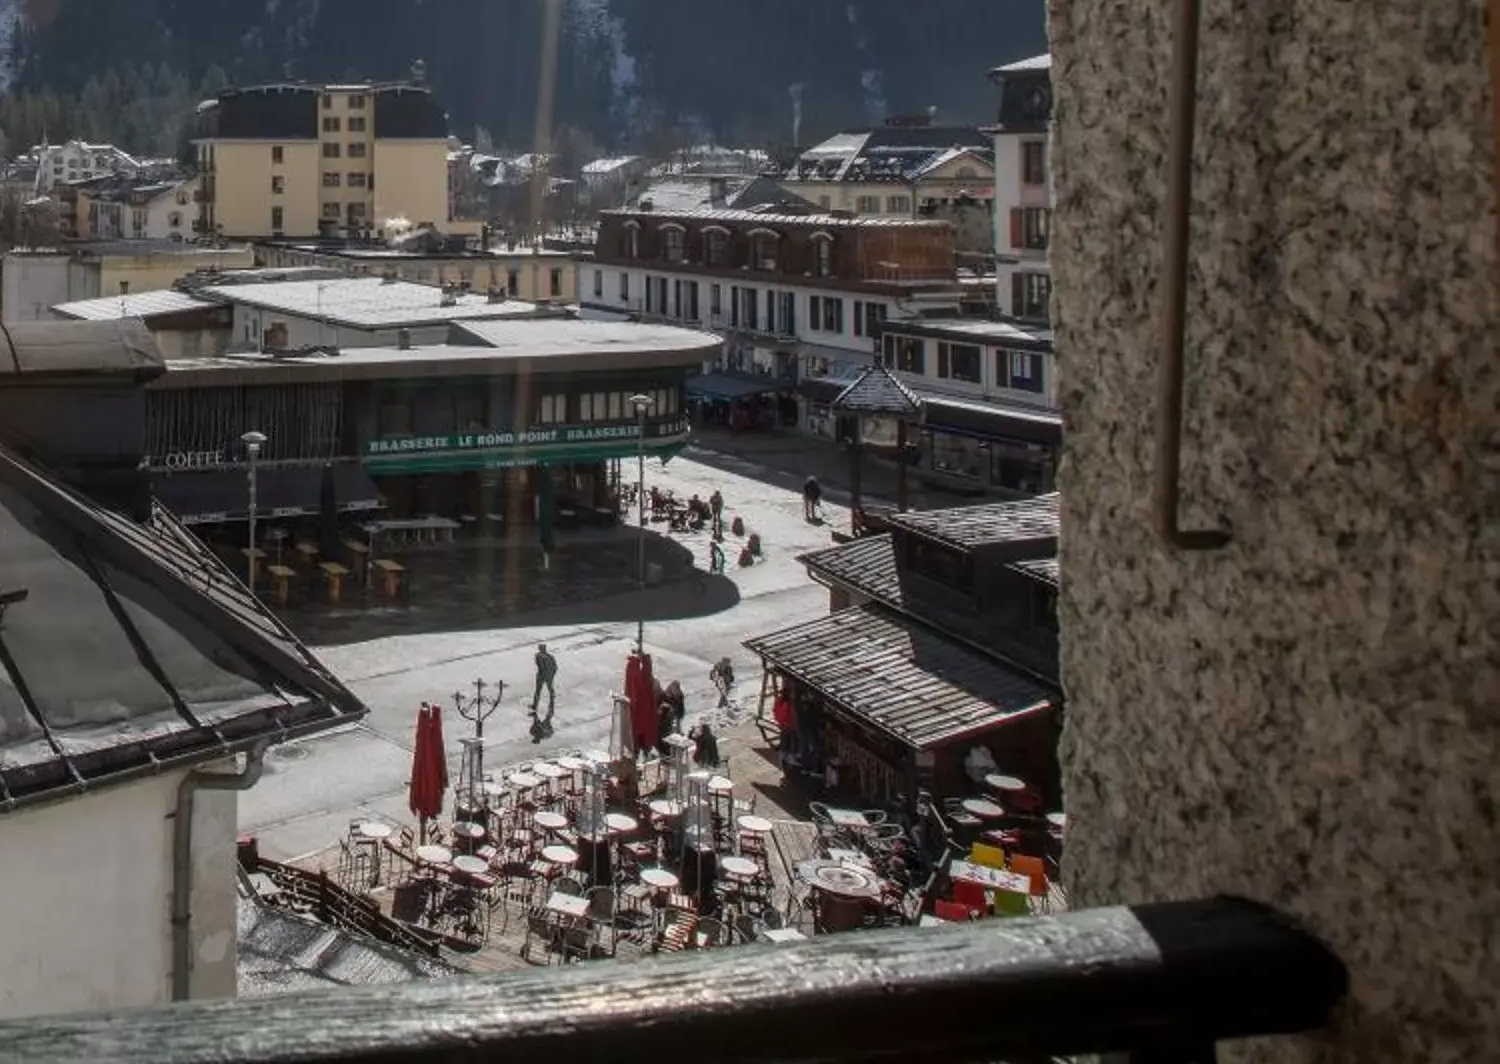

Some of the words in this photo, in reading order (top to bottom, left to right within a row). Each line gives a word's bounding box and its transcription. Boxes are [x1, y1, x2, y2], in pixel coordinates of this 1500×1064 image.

[370, 437, 448, 452] BRASSERIE
[458, 434, 474, 447] LE
[518, 430, 556, 443] POINT
[567, 426, 640, 440] BRASSERIE
